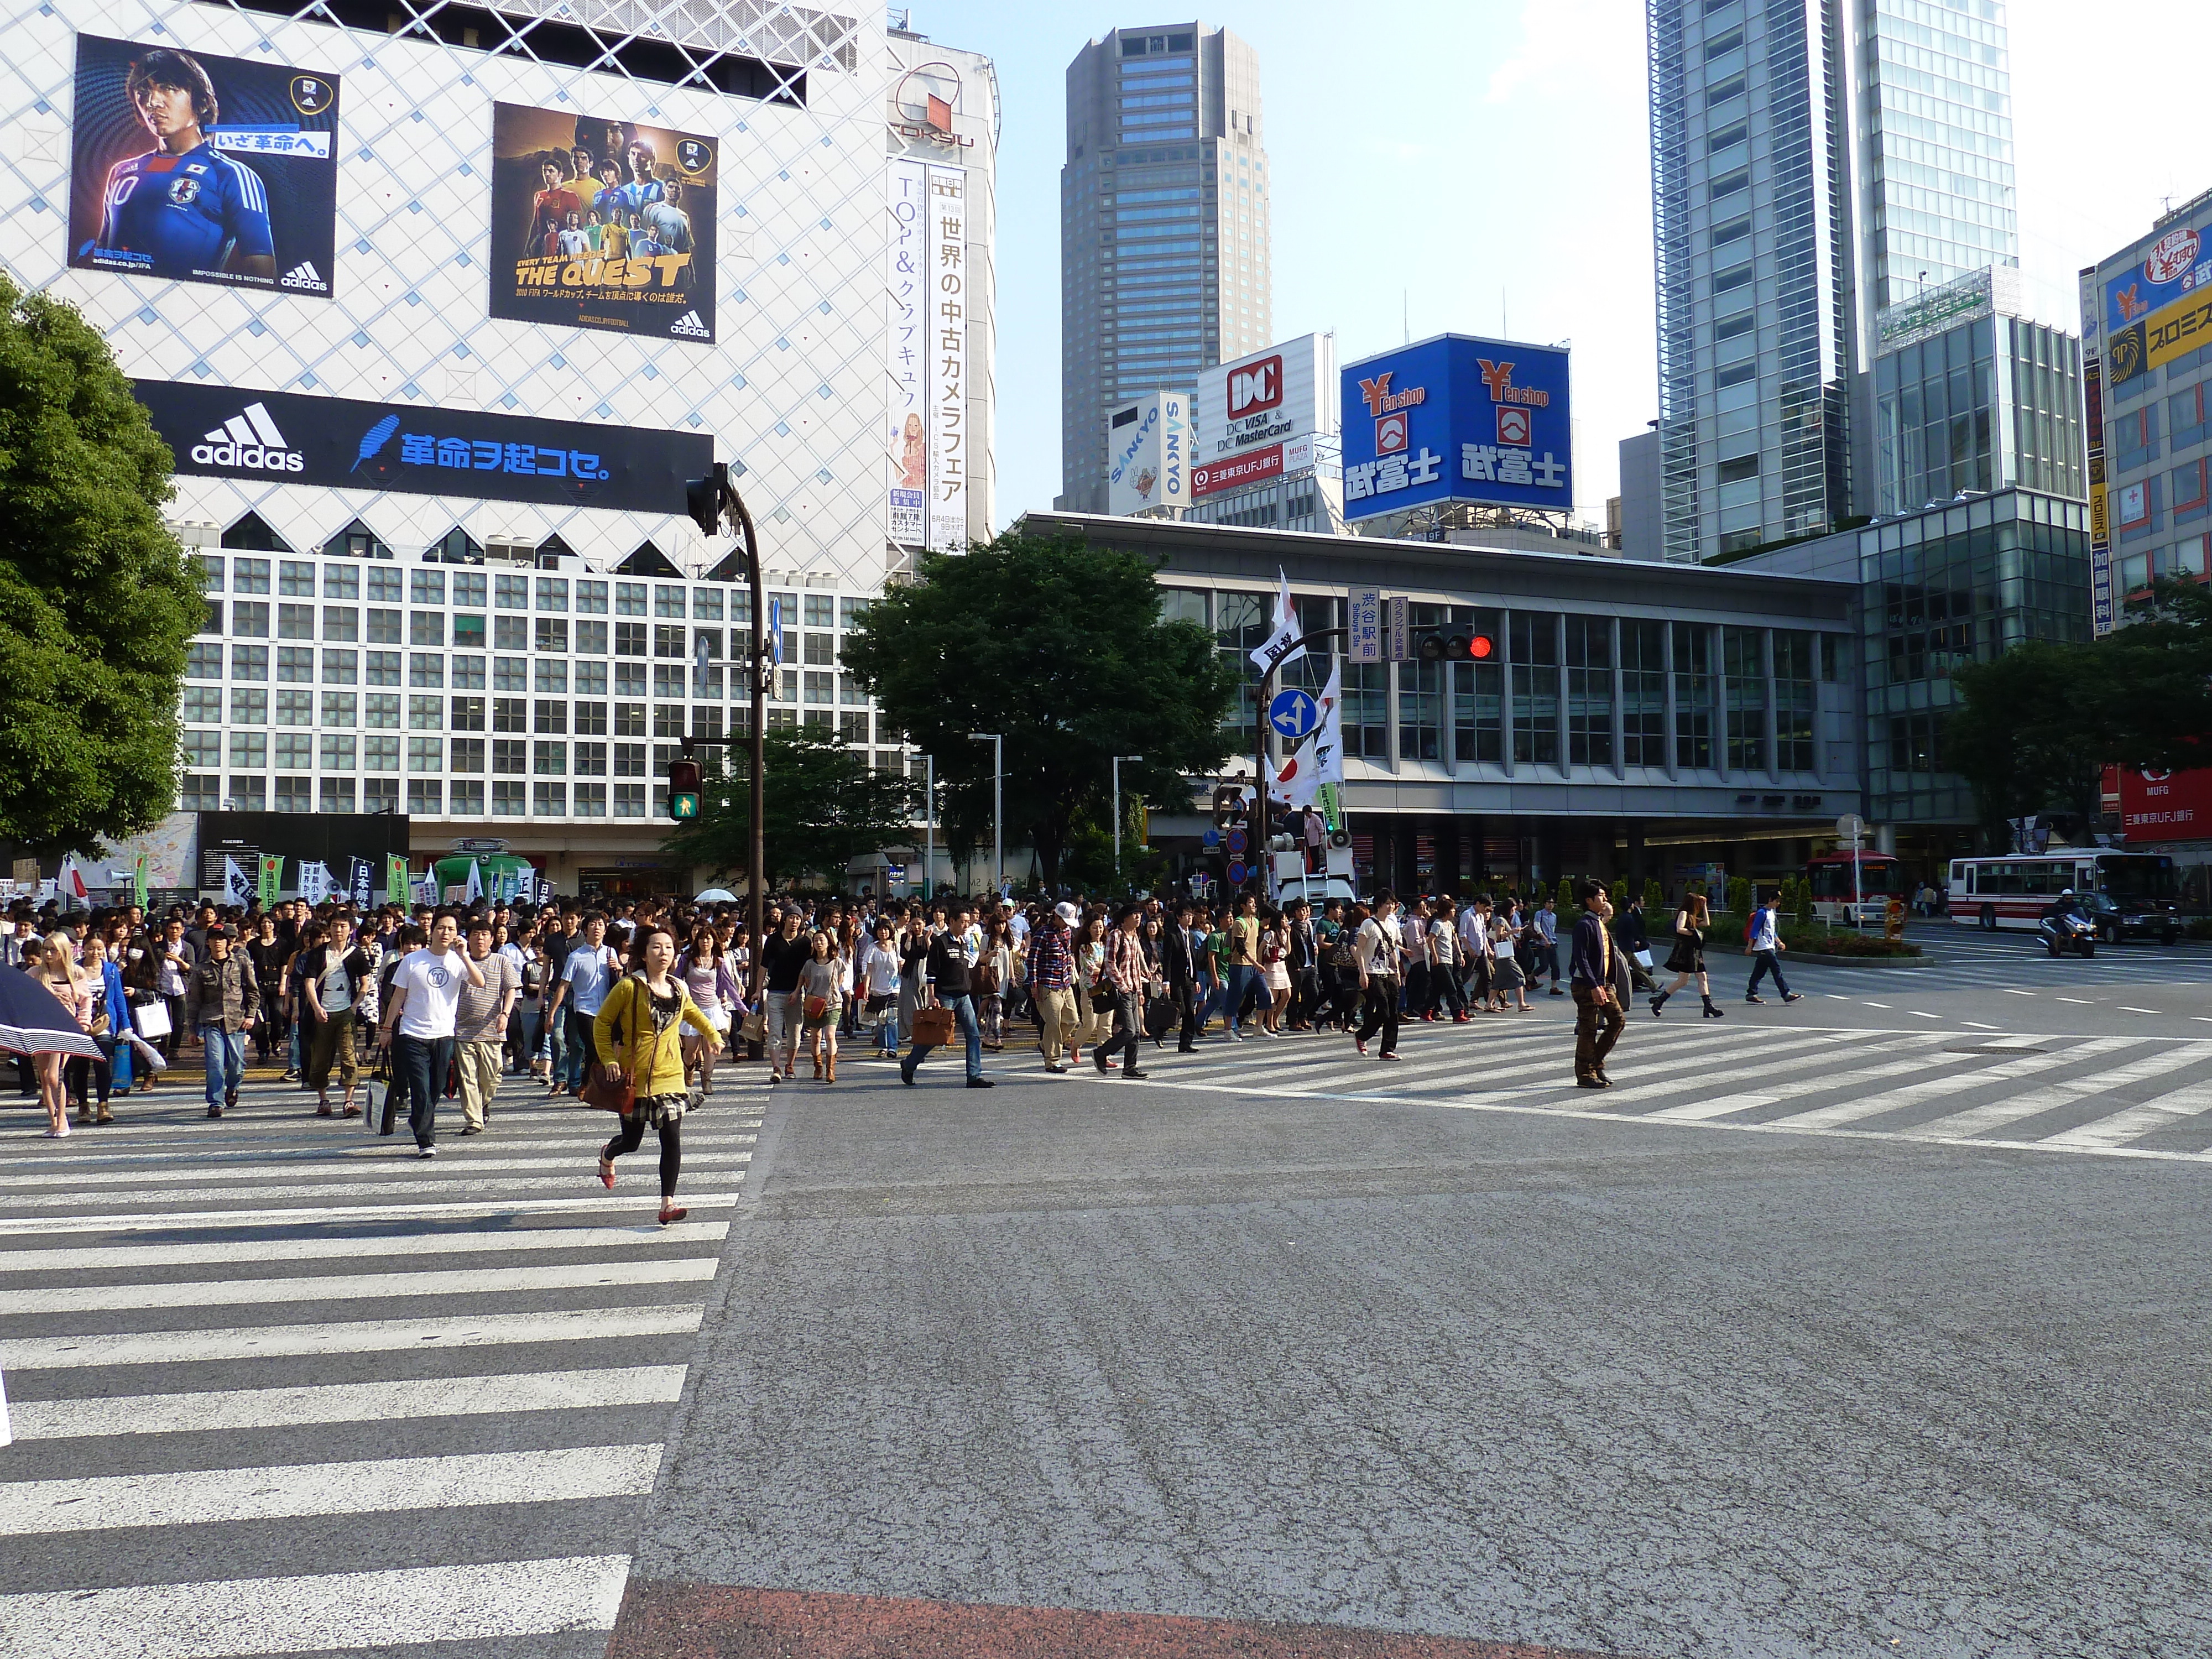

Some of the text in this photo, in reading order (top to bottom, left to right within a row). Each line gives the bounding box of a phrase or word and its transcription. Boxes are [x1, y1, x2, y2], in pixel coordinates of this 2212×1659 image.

[218, 134, 326, 156] いざ革命へ。
[515, 253, 691, 287] THE QUEST
[517, 249, 607, 267] EVERY TEAM NEEDS
[192, 269, 234, 280] IMPOSSIBLE
[244, 275, 274, 285] NOTHING
[281, 276, 327, 291] adidas
[529, 288, 540, 298] FIFA
[671, 325, 711, 338] adidas
[2149, 302, 2212, 354] プロミス
[940, 216, 962, 502] 世界の中古カメラフェア
[2085, 347, 2097, 357] 9F
[1397, 386, 1425, 408] shop
[1521, 387, 1549, 408] shop
[1217, 419, 1292, 452] DC MasterCard
[1226, 410, 1283, 436] DC VISA &
[191, 442, 304, 472] adidas
[401, 433, 610, 481] 革命ヲ起コセ。
[1112, 407, 1158, 484] SANKYO
[1166, 401, 1186, 494] SANKYO
[1289, 444, 1307, 455] MUFG
[1289, 452, 1308, 463] PLAZA
[1212, 454, 1280, 483] 三菱東京UFJ銀行
[1345, 447, 1442, 501] 武富士
[1462, 442, 1566, 487] 武富士
[2094, 553, 2111, 619] 加藤眼科
[1352, 603, 1360, 633] Shibuya
[1362, 593, 1376, 656] 渋谷駅前
[1394, 599, 1405, 659] スクランブル交差点
[2096, 622, 2111, 633] 5F
[2146, 785, 2169, 796] MUFG
[2125, 809, 2194, 826] 三菱東京UFJ銀行
